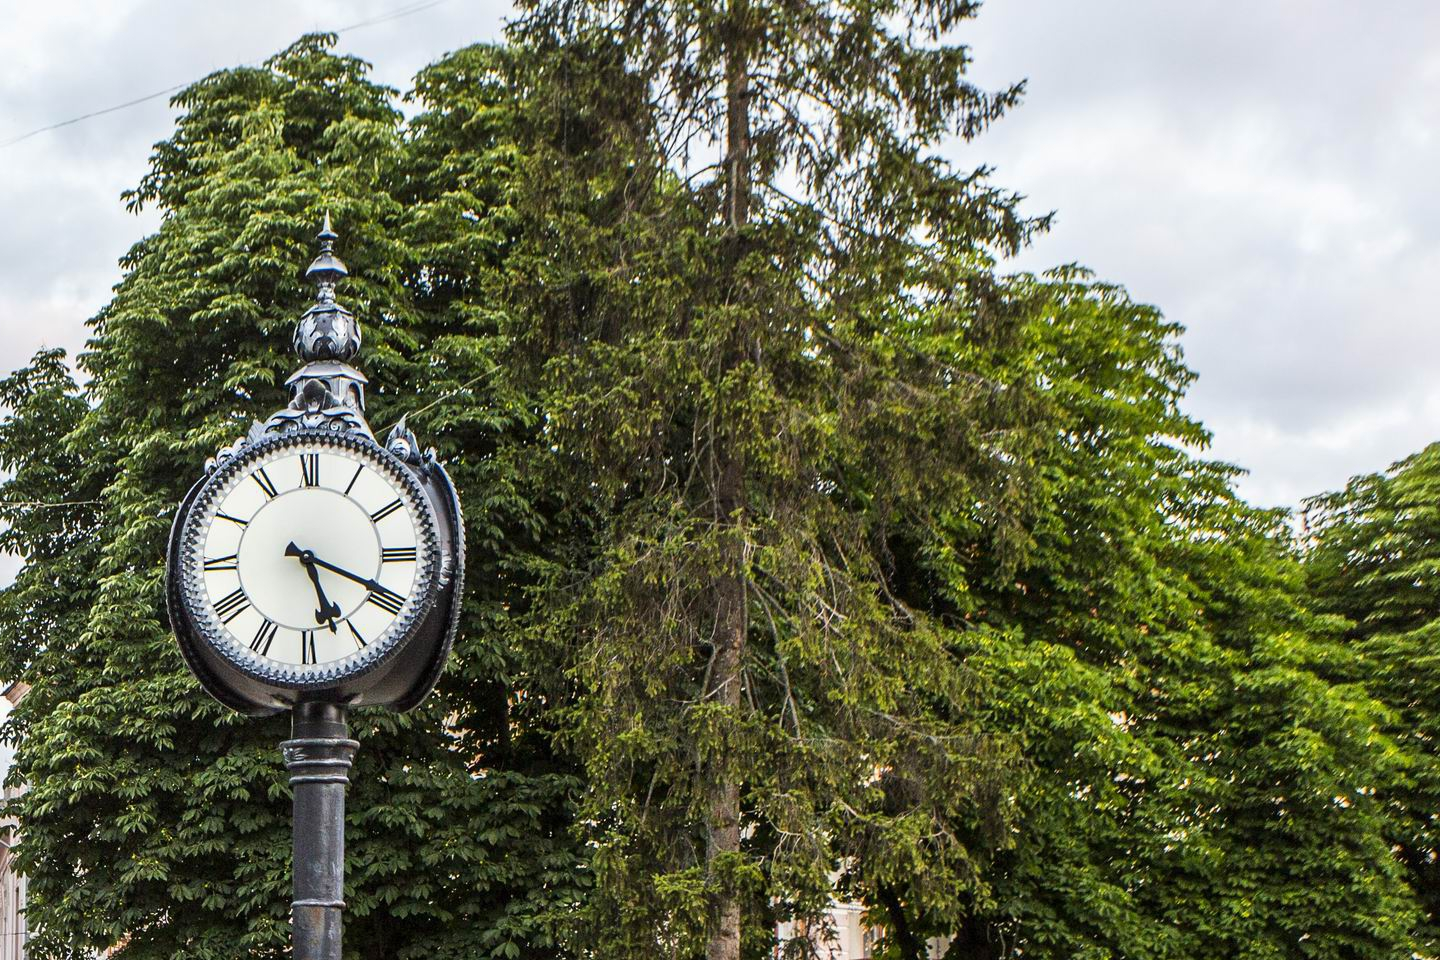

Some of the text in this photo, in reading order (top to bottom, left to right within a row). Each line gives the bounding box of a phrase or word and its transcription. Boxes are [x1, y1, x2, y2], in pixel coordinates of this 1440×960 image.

[251, 467, 279, 503] XI
[299, 454, 320, 488] XII
[344, 463, 364, 496] I
[215, 507, 249, 531] X
[371, 497, 405, 523] II
[204, 554, 238, 571] IX
[382, 547, 417, 563] III
[213, 587, 251, 625] VIII
[249, 618, 279, 657] VII
[301, 630, 317, 665] VI
[346, 618, 367, 651] V
